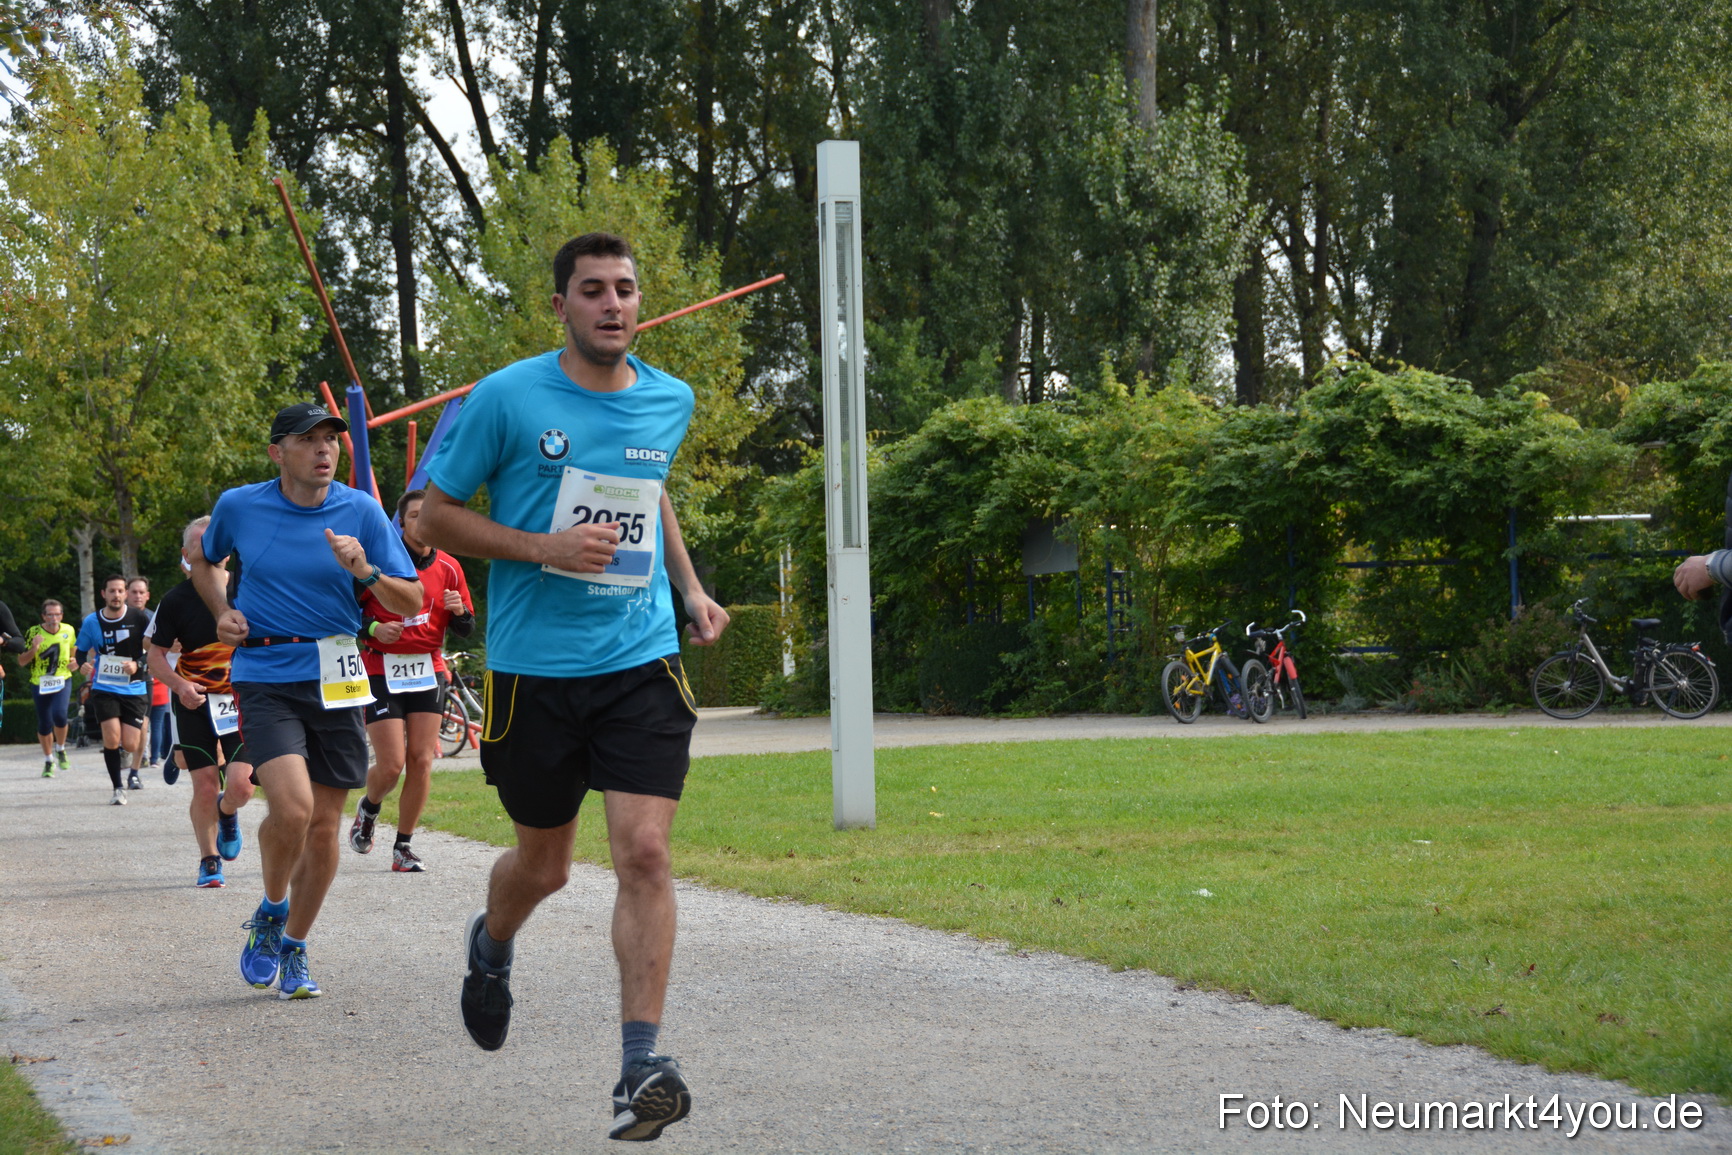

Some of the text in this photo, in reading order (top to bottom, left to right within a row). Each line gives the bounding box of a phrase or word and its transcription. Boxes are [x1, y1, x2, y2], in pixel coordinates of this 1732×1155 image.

[624, 447, 669, 463] BOCK
[606, 486, 640, 498] BOCK
[391, 661, 425, 678] 2117
